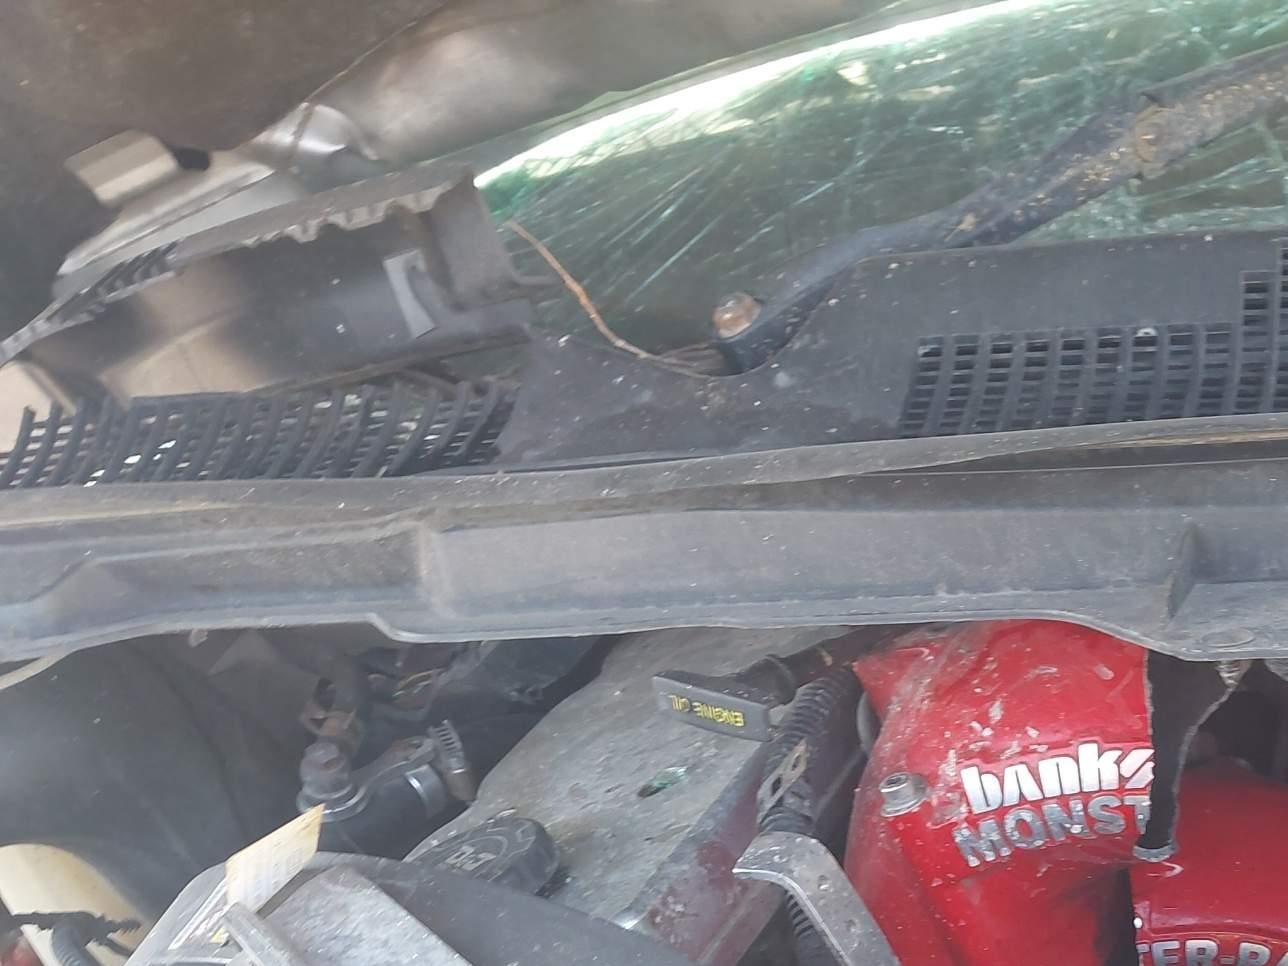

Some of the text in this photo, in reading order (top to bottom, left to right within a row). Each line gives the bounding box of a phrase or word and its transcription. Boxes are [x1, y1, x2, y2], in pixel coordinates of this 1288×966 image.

[668, 695, 745, 727] ENGINE OIL
[953, 795, 1152, 867] MONST
